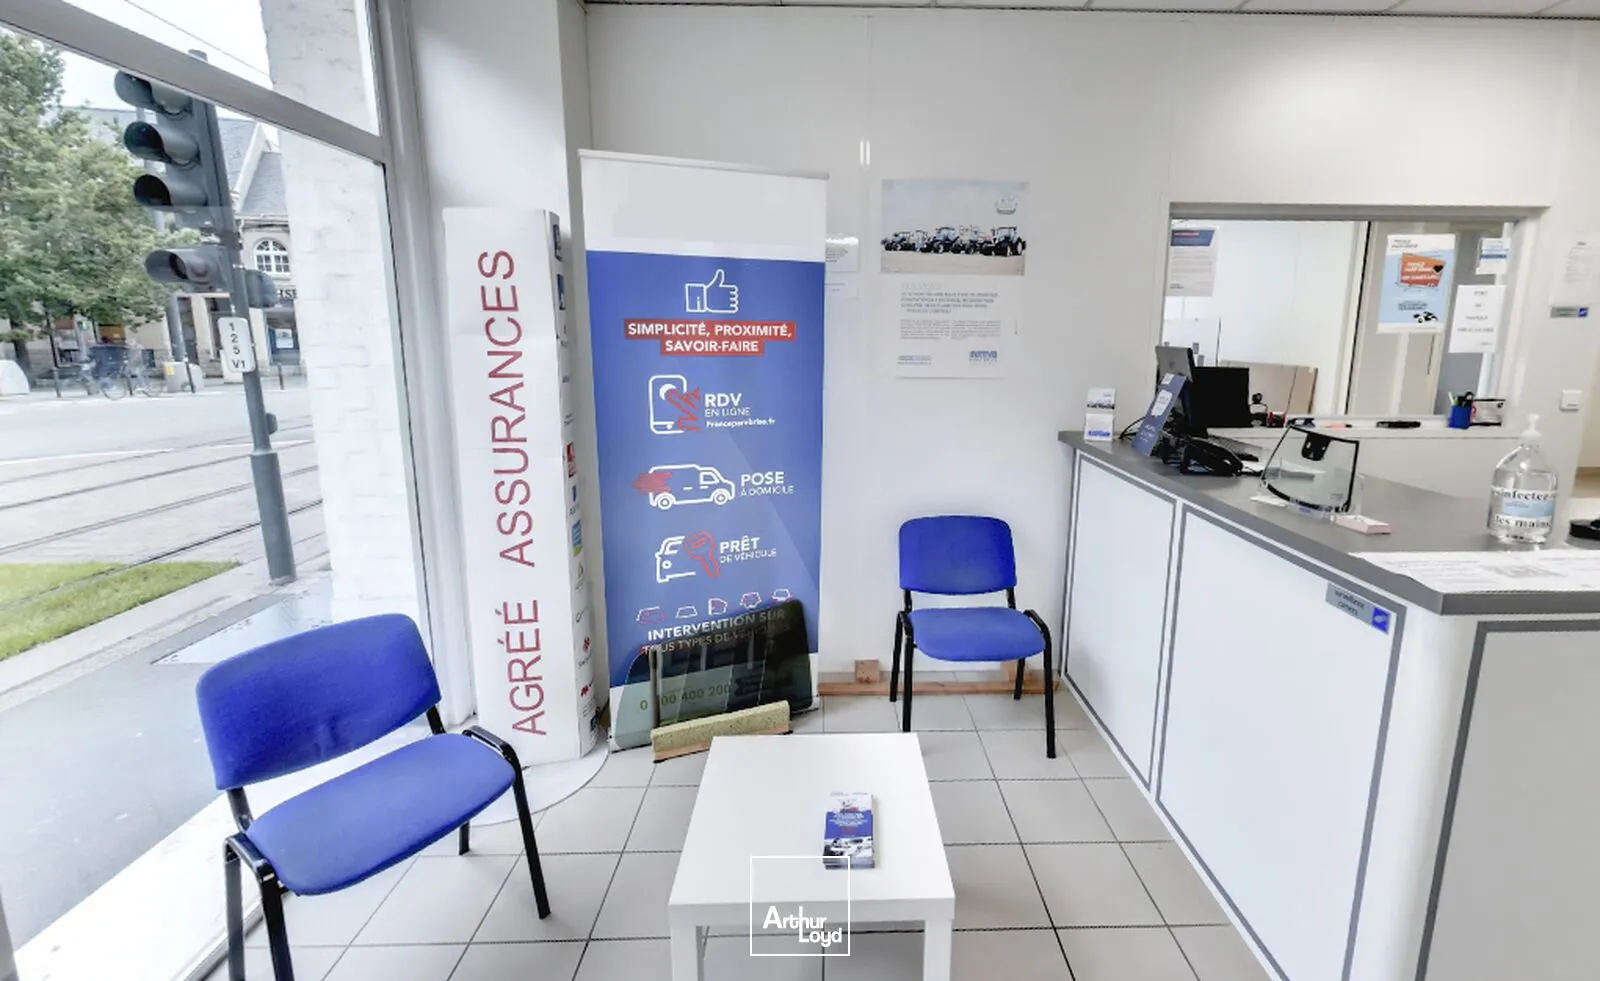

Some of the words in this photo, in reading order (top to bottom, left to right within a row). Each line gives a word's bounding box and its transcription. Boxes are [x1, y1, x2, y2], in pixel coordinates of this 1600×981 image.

[229, 322, 235, 331] 1
[627, 322, 710, 338] SIMPLICITÉ,
[715, 323, 792, 338] PROXIMITÉ,
[230, 333, 239, 343] 2
[664, 340, 759, 353] SAVOIR-FAIRE
[231, 359, 246, 369] V1
[704, 393, 742, 407] RDV
[478, 249, 537, 569] ASSURANCES
[704, 408, 719, 418] EN
[721, 407, 751, 417] LIGNE
[740, 471, 785, 487] POSE
[748, 486, 795, 497] DOMICILE
[719, 535, 761, 554] PRÊT
[719, 554, 733, 564] DE
[734, 548, 777, 562] VÉHICULE
[647, 613, 755, 641] INTERVENTION
[759, 608, 786, 623] SUR
[495, 598, 547, 737] AGRÉÉ
